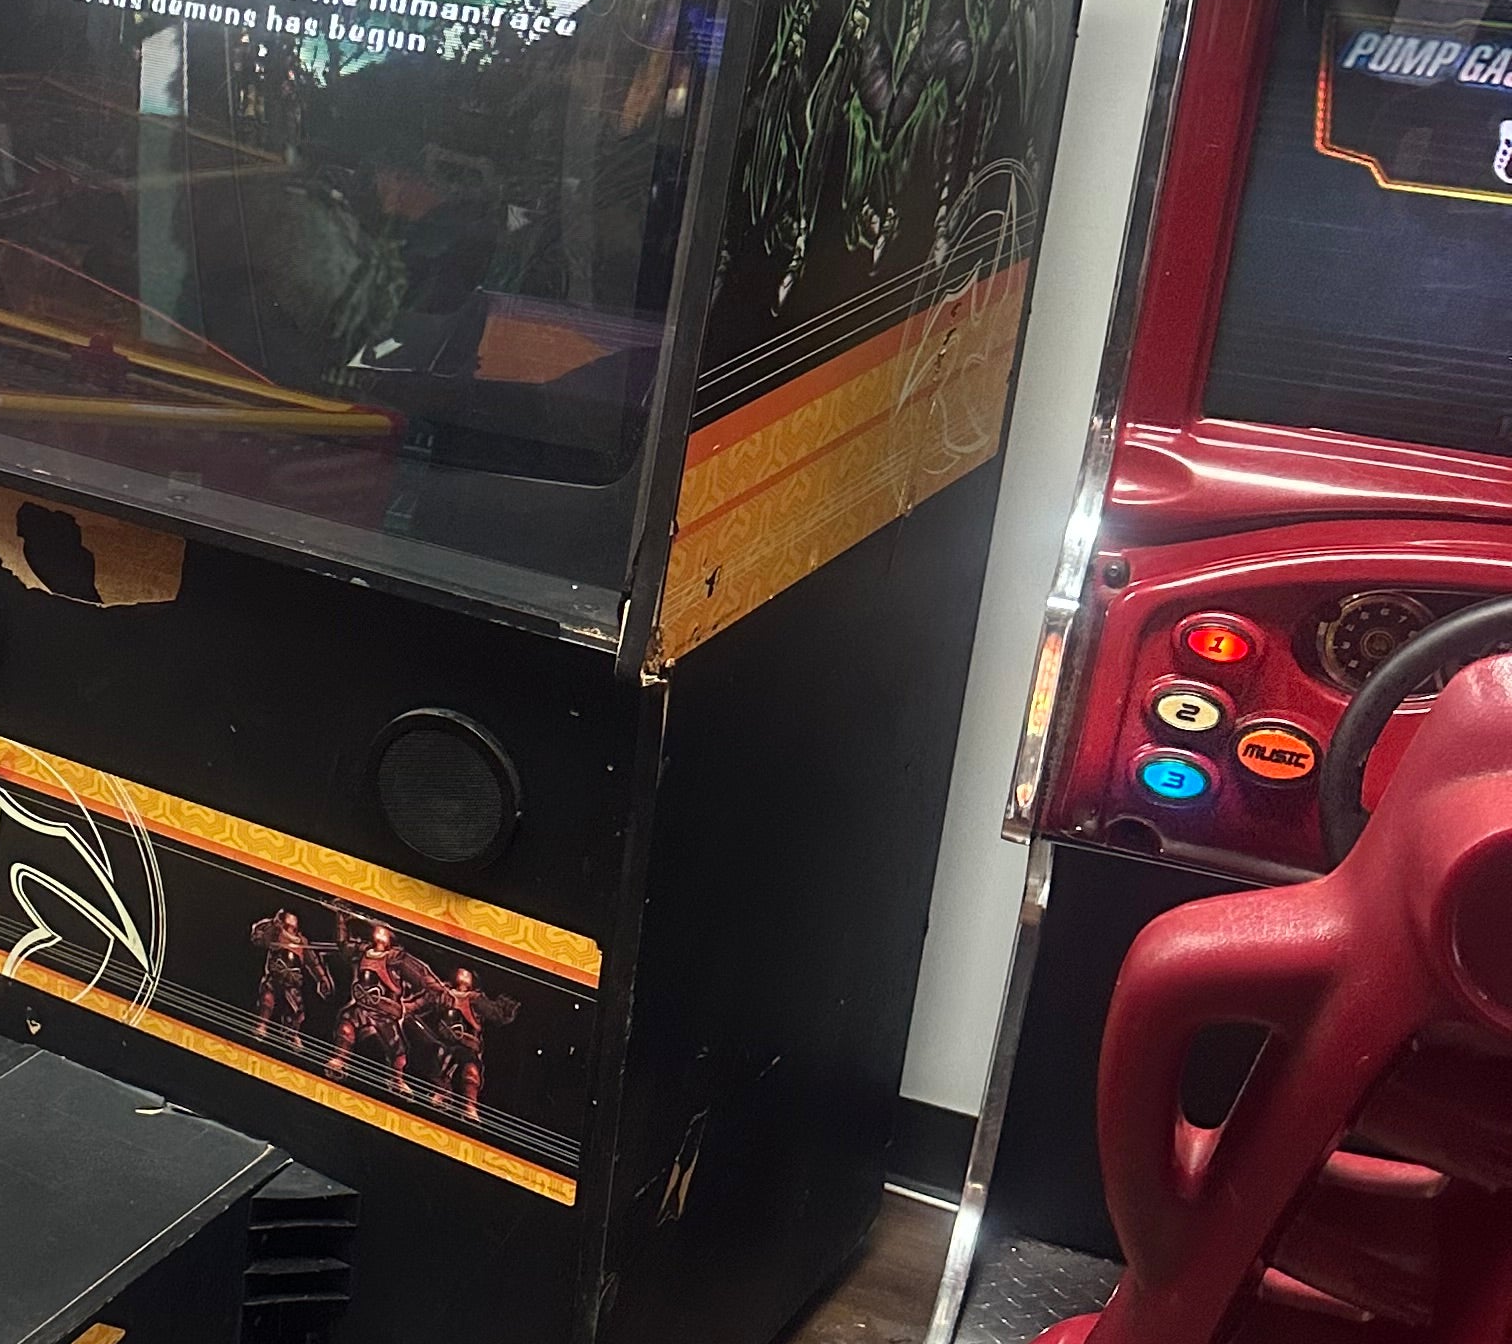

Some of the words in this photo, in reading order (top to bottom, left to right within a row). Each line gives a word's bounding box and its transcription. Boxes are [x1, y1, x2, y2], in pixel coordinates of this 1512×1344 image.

[265, 4, 319, 36] has
[329, 14, 427, 53] begun
[1342, 30, 1463, 77] PUMP
[1209, 637, 1225, 653] 1
[1176, 703, 1200, 722] 2
[1242, 742, 1311, 770] MUSIC
[1163, 772, 1186, 790] 3
